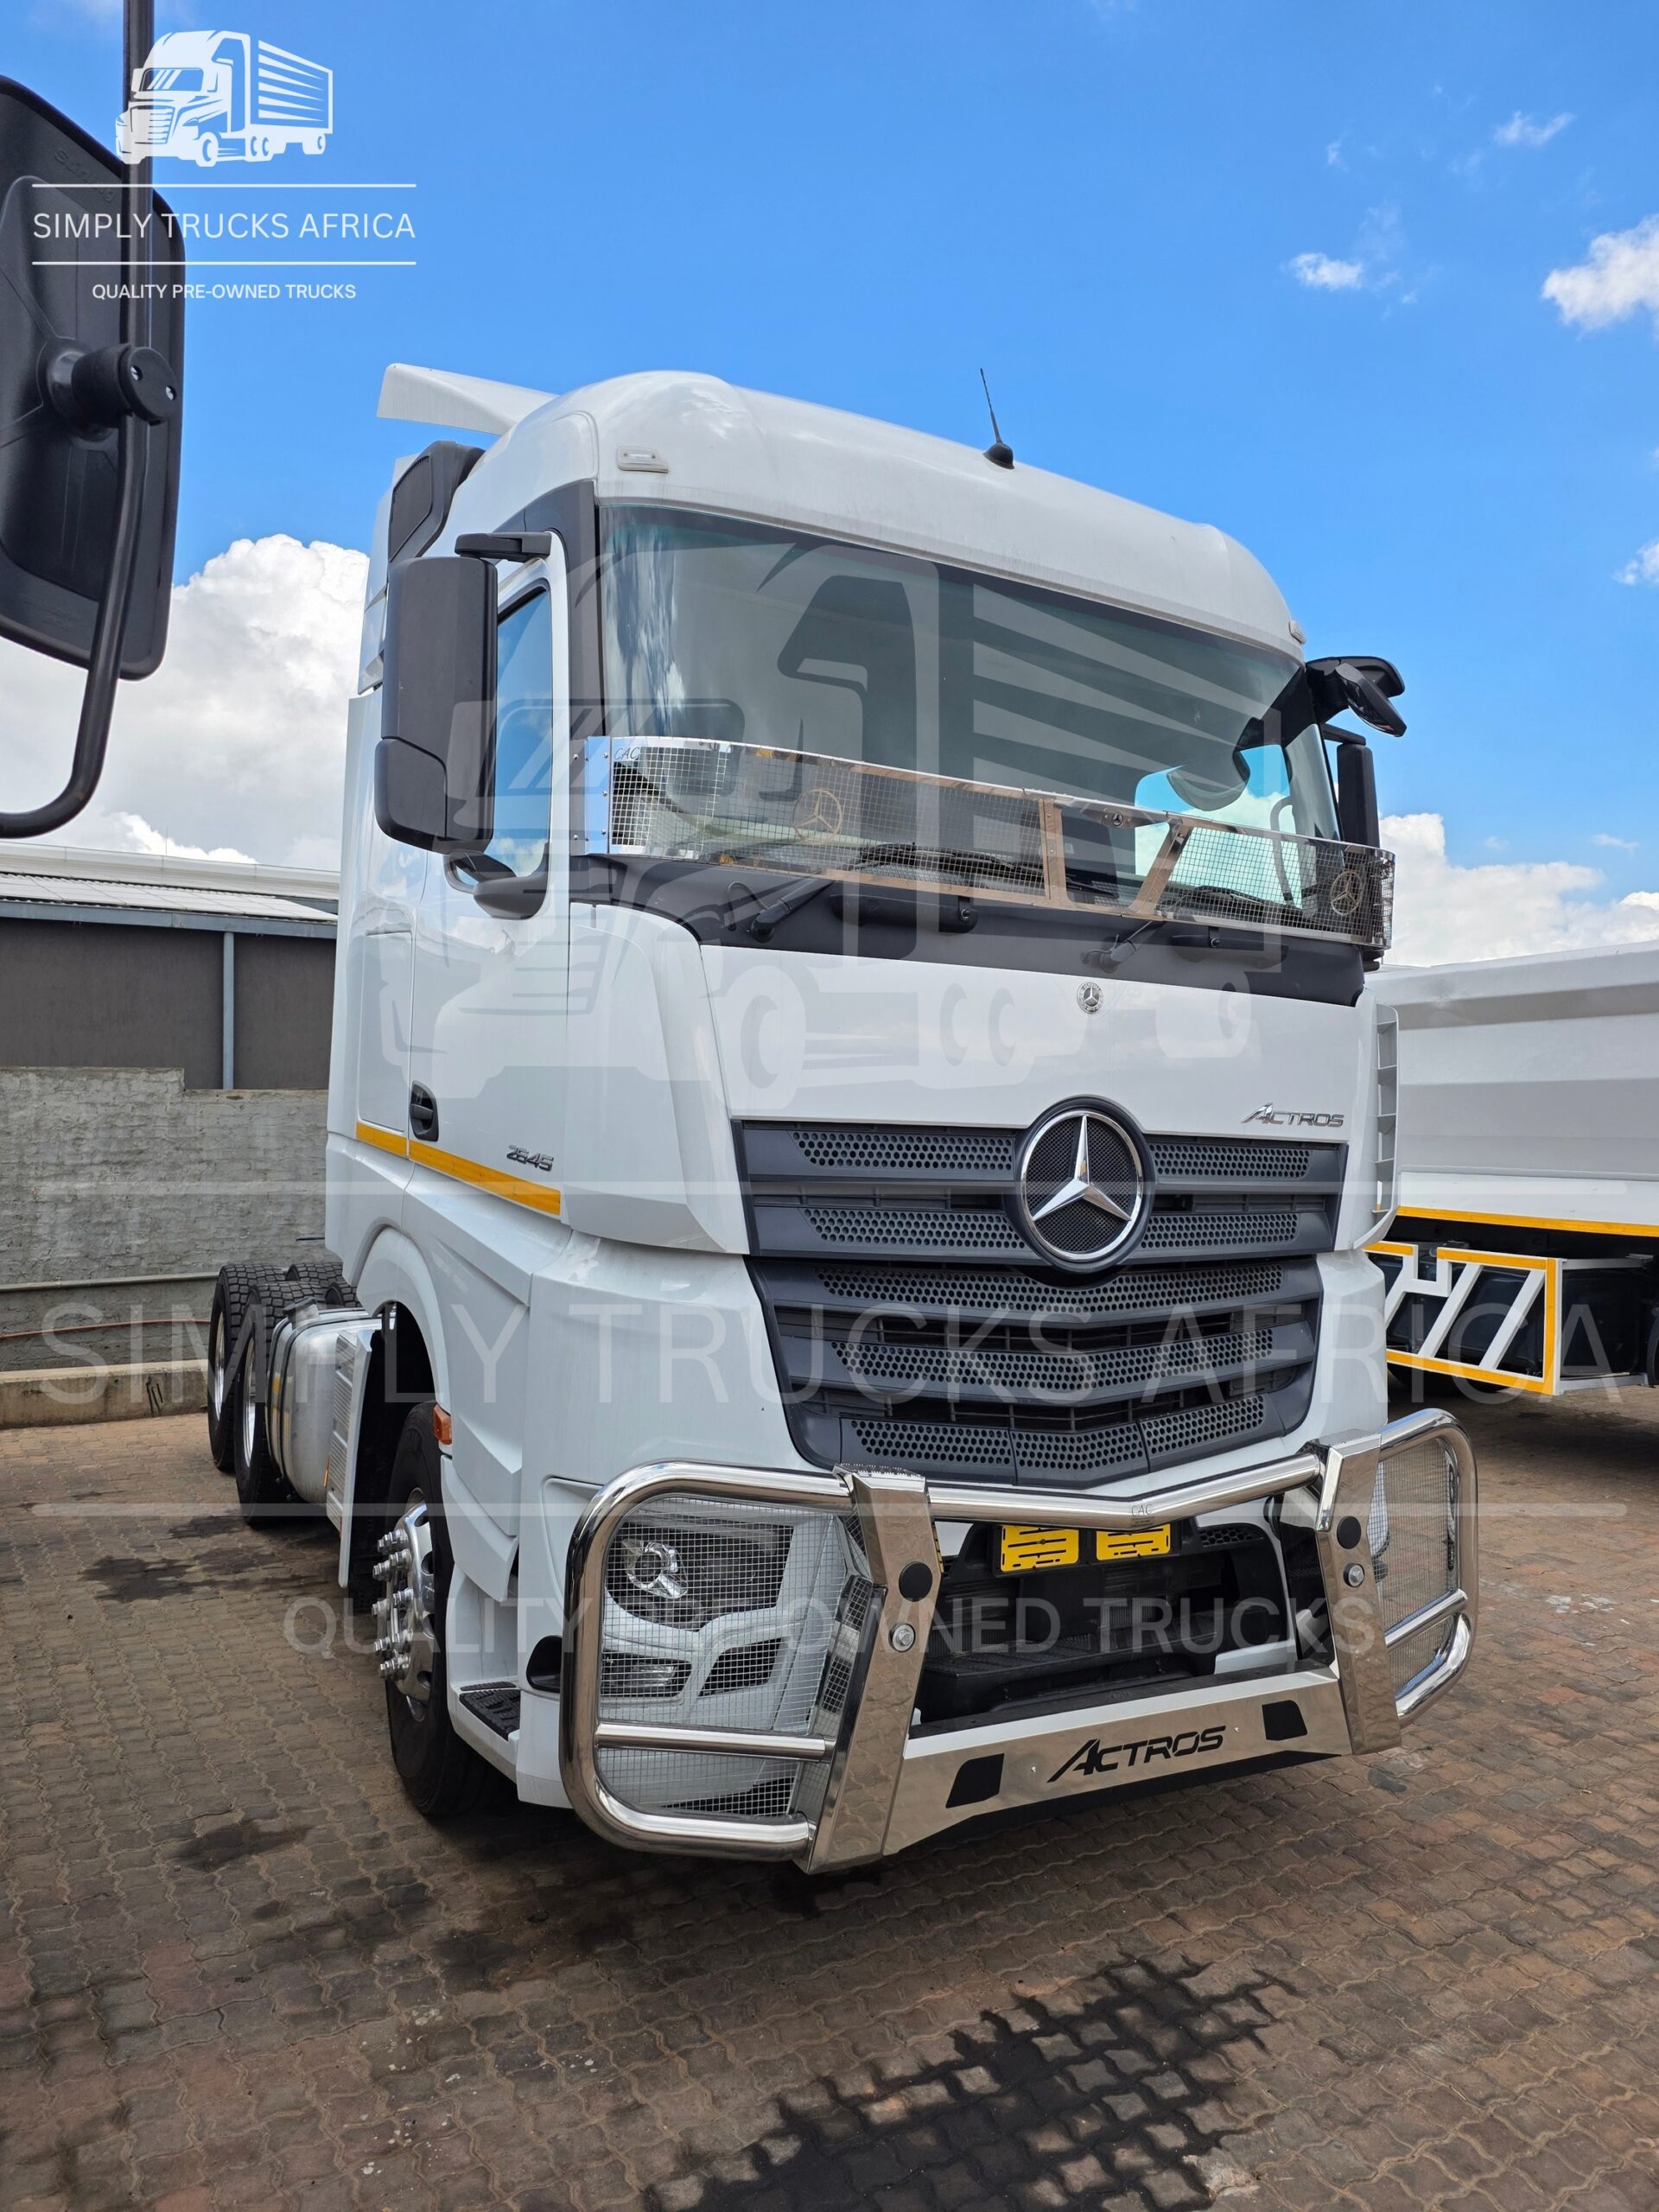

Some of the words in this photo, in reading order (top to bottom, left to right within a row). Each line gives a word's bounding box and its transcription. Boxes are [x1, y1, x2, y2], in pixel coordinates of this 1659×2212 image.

[1241, 1102, 1344, 1128] ACTROS
[506, 1145, 554, 1172] 2645
[1046, 1726, 1227, 1783] ACTROS
